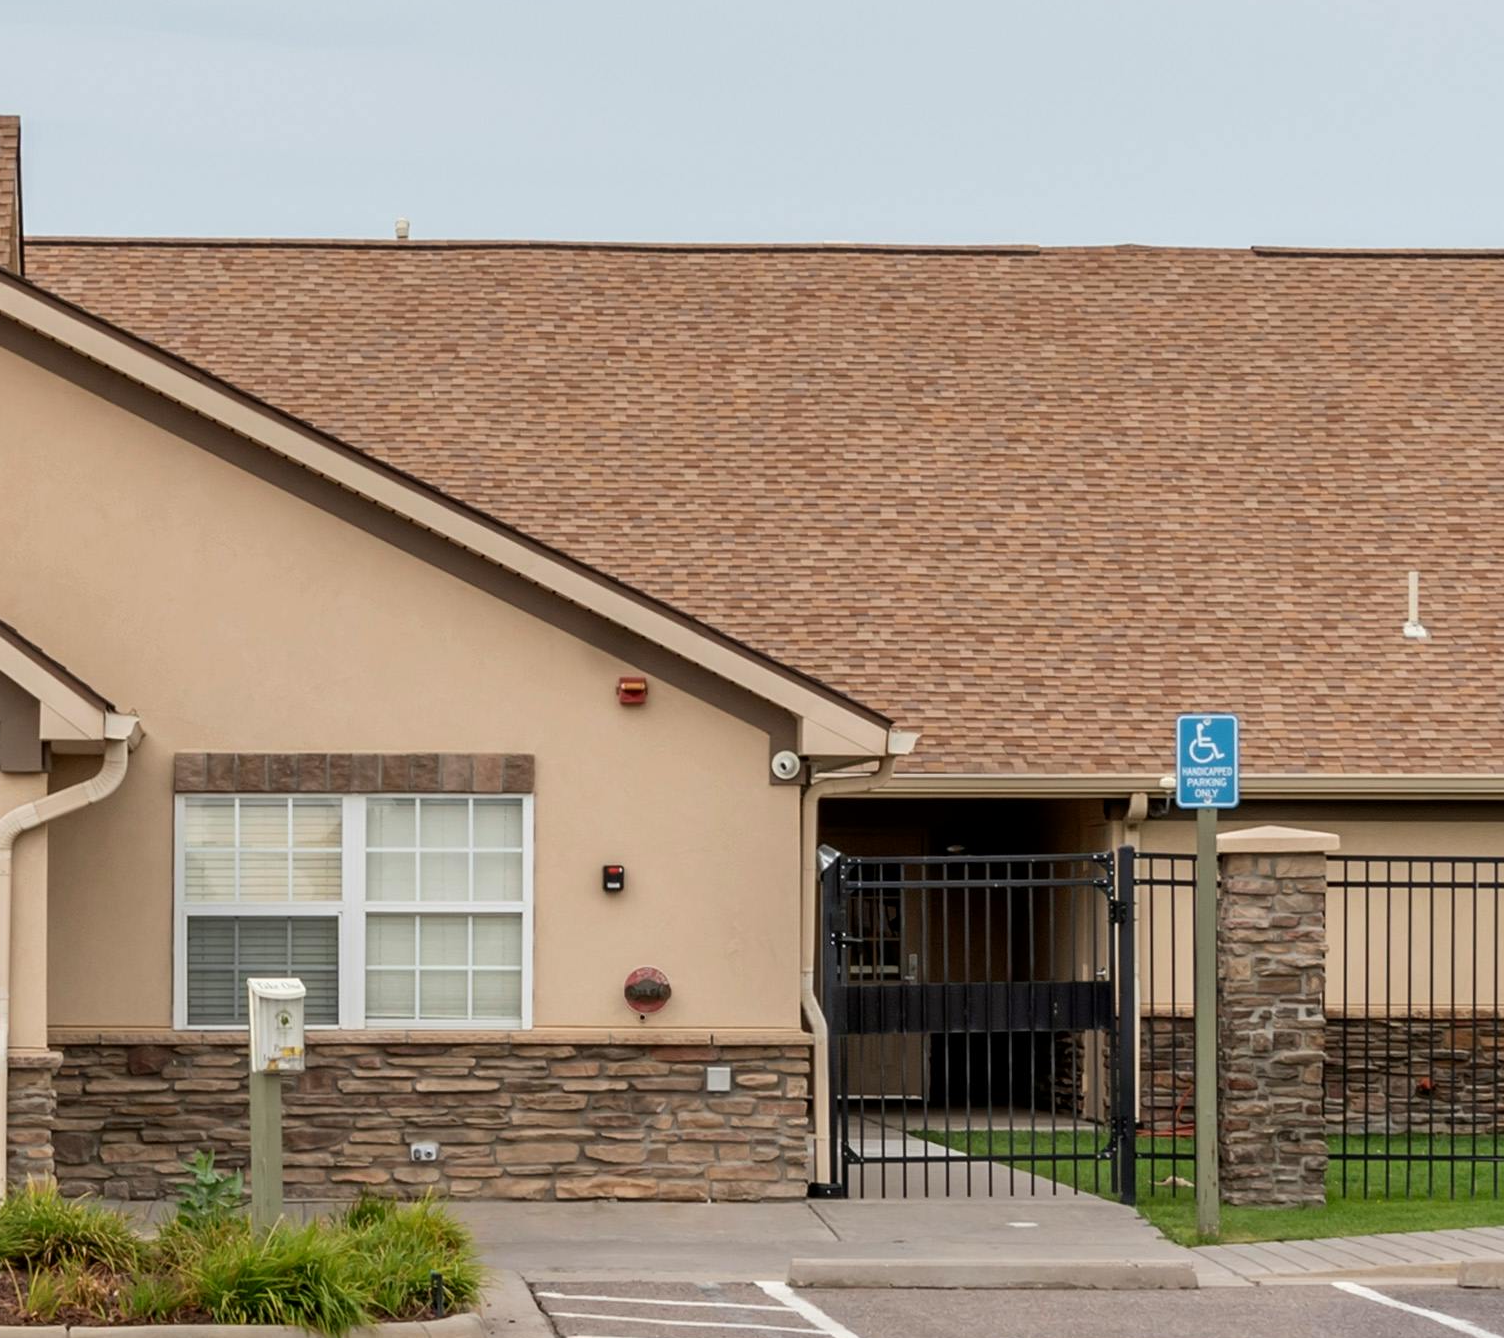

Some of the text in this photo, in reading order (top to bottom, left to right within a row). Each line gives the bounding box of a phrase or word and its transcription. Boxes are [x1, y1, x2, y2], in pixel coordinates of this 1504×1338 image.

[1182, 766, 1233, 776] HANDICAPPED
[1187, 778, 1227, 787] PARKING
[1195, 789, 1218, 798] ONLY
